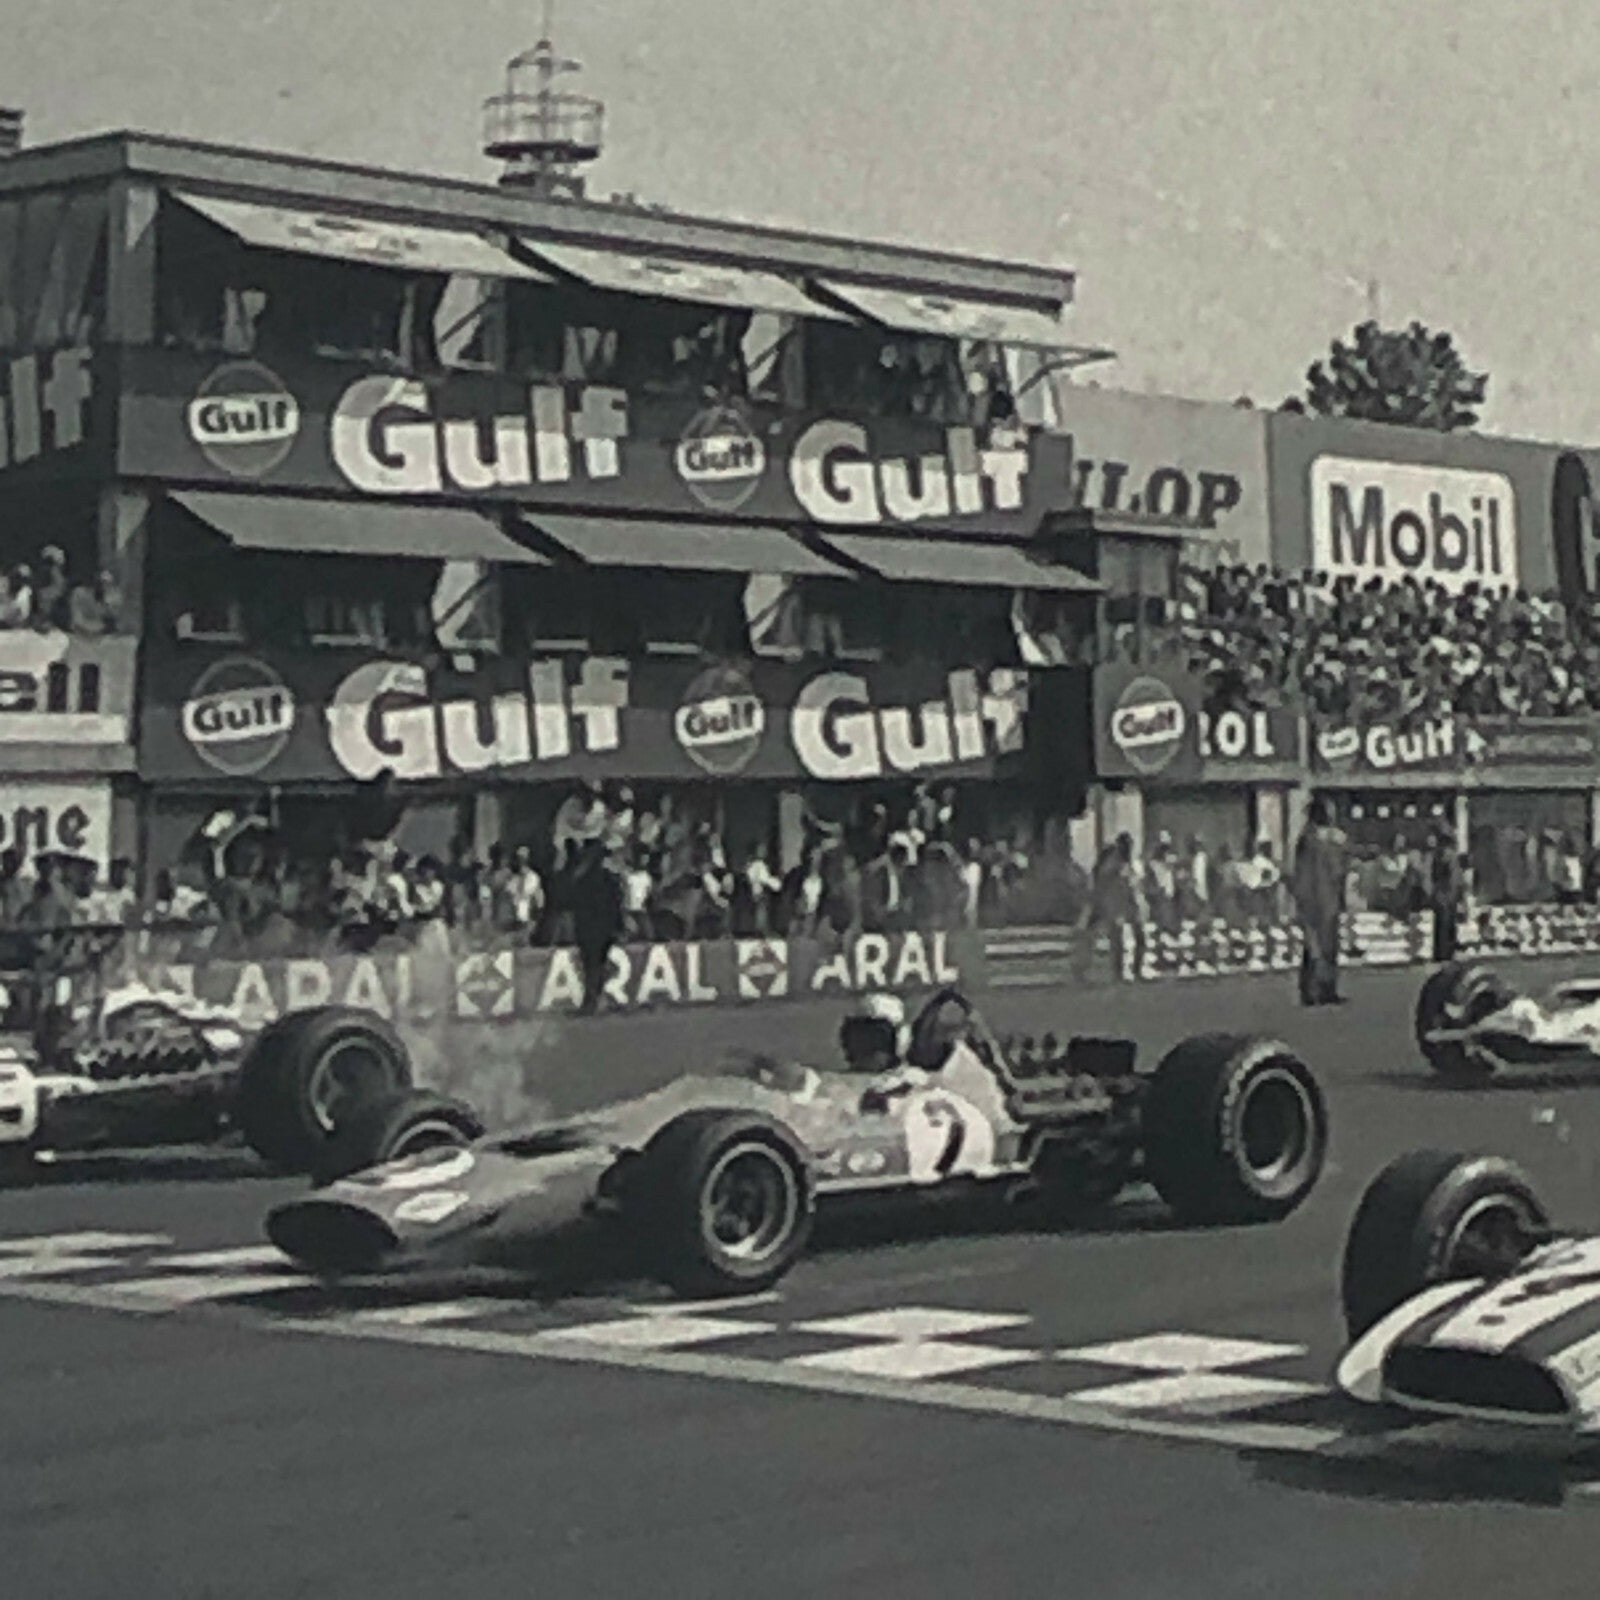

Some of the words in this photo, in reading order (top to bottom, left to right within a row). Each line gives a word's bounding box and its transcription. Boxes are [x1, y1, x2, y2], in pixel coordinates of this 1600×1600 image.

[0, 347, 93, 467] lf
[199, 398, 288, 433] Gulf
[332, 374, 627, 493] Gulf
[686, 439, 754, 471] Gulf
[790, 419, 1028, 523] Gulf
[1328, 482, 1502, 575] Mobil
[192, 694, 286, 733] Gulf
[329, 656, 628, 780] Gulf
[684, 701, 754, 738] Gulf
[791, 667, 1028, 779] Gulf
[1366, 716, 1456, 768] Gulf
